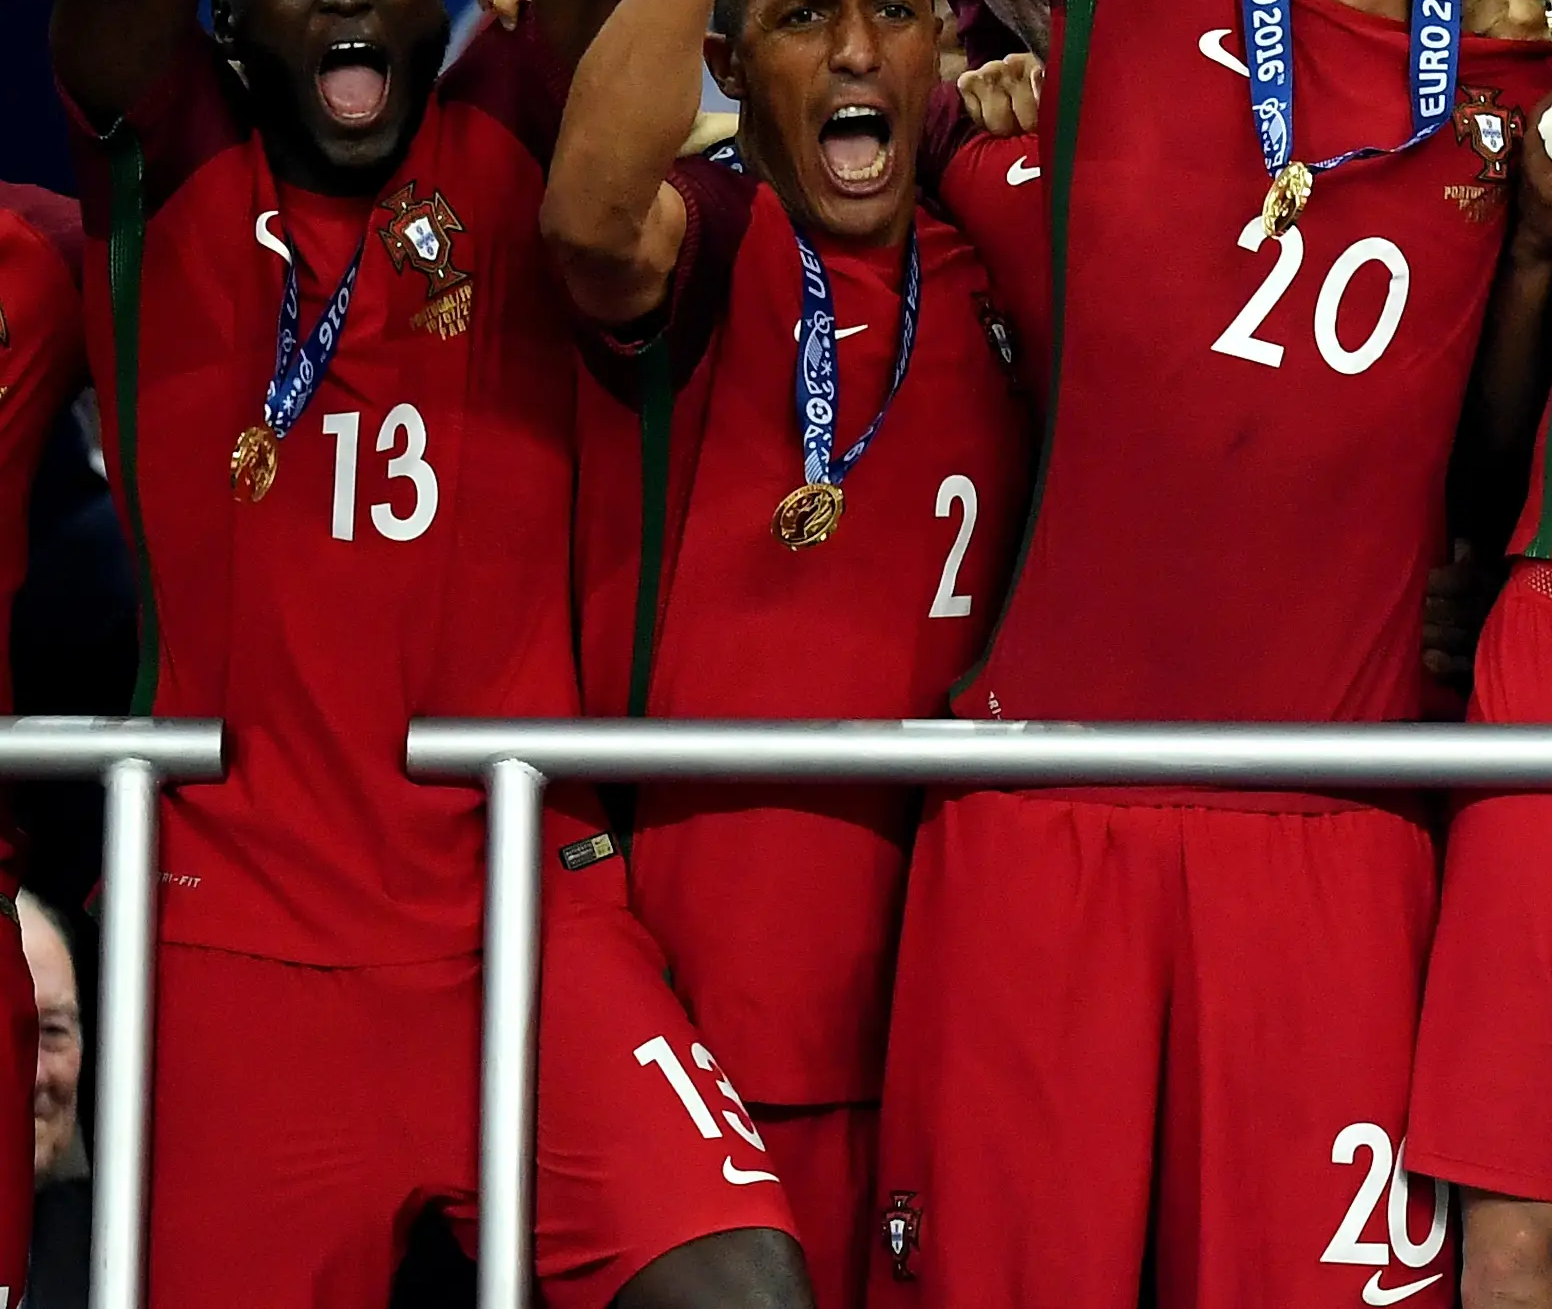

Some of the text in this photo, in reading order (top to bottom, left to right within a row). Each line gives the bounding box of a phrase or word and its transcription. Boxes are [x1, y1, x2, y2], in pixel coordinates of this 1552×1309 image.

[1252, 7, 1286, 83] 2016
[1418, 24, 1452, 119] EURO
[1211, 217, 1410, 375] 20
[322, 402, 440, 542] 13
[929, 474, 978, 619] 2
[161, 872, 202, 888] RI-FIT
[633, 1035, 766, 1152] 13
[1320, 1122, 1449, 1267] 20
